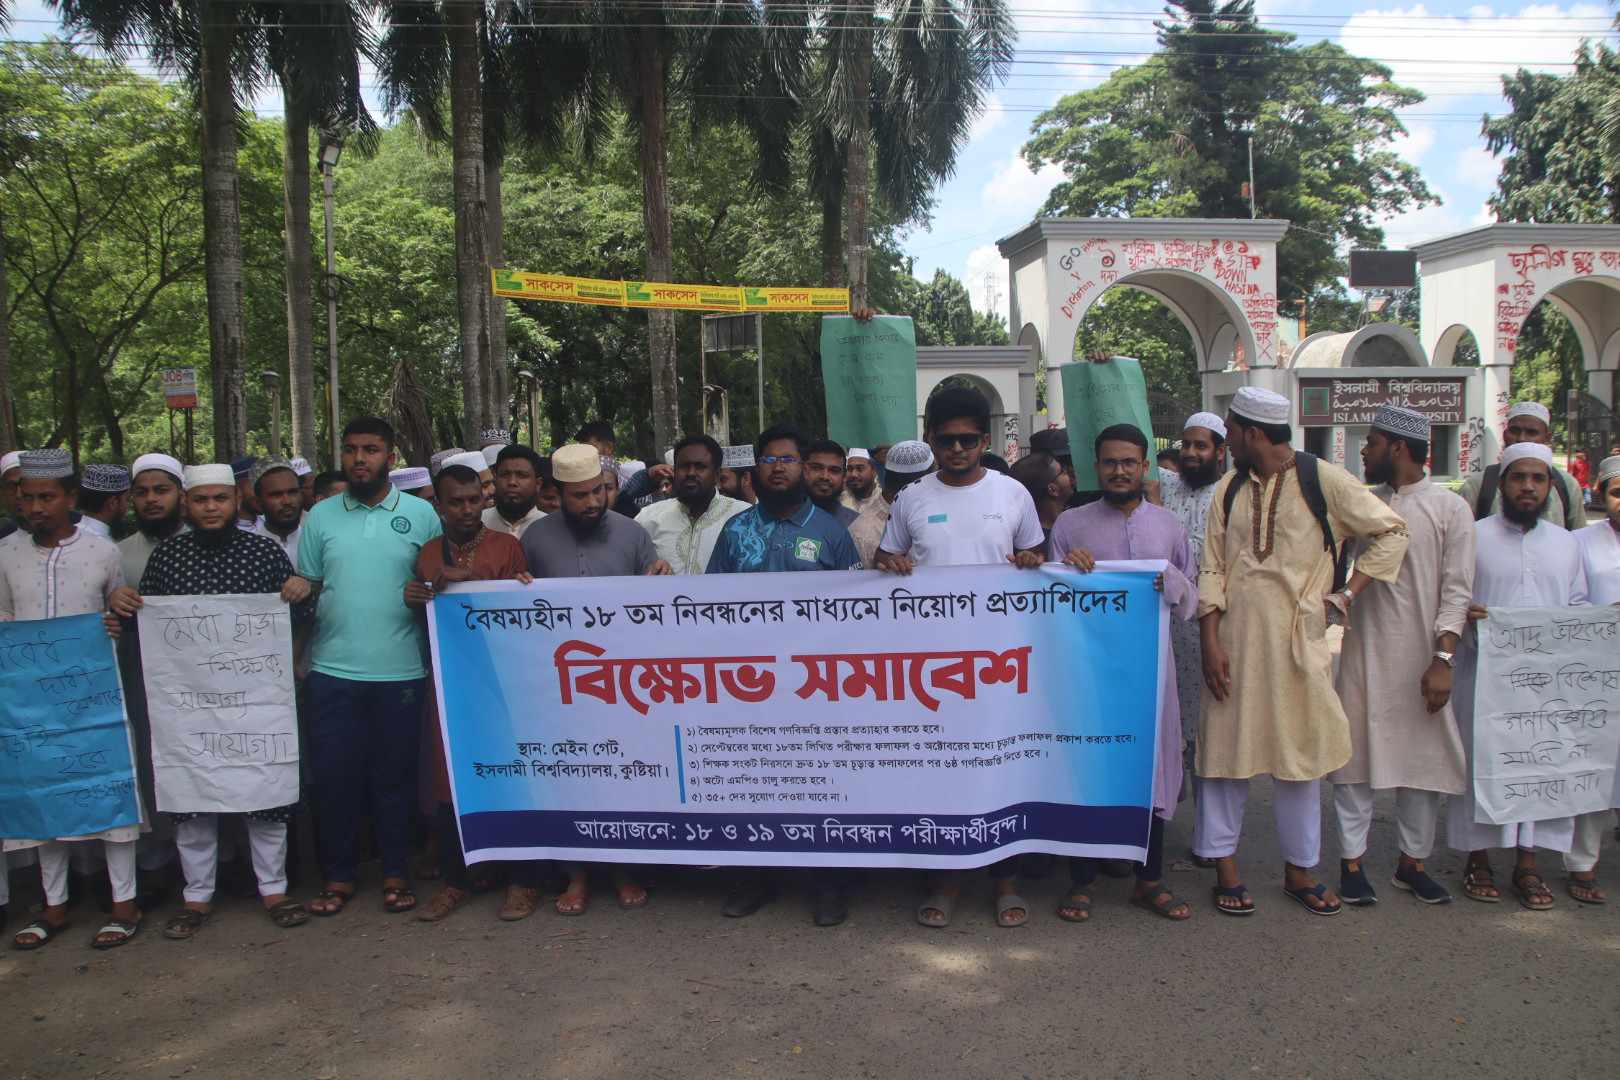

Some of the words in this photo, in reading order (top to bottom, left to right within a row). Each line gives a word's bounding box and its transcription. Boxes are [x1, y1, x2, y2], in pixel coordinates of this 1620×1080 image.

[526, 278, 574, 294] সাকসেস
[653, 288, 698, 302] সাকসেস
[1333, 378, 1379, 395] ইসলামী
[1388, 379, 1462, 395] বিশ্ববিদ্যালয়
[1333, 412, 1376, 423] ISLAMI
[463, 598, 573, 631] বৈষম্যহীন
[584, 604, 616, 629] ১৮
[624, 603, 664, 626] তম
[672, 596, 785, 625] নিবন্ধনের
[792, 597, 881, 624] মাধ্যমে
[889, 588, 977, 620] নিয়োগ
[986, 582, 1129, 617] প্রত্যাশিদের
[553, 640, 777, 716] বিক্ষোভ
[791, 645, 1033, 712] সমাবেশ
[749, 724, 776, 735] বিশেষ
[893, 725, 920, 734] করতে
[551, 740, 588, 758] মেইন
[593, 739, 625, 759] গেট,
[875, 742, 910, 752] ফলাফল
[1018, 731, 1053, 742] ফলাফল
[1055, 734, 1082, 744] প্রকাশ
[1085, 735, 1112, 744] করতে
[473, 760, 527, 779] ইসলামী
[531, 760, 618, 780] বিশ্ববিদ্যালয়,
[575, 818, 678, 842] আয়োজনে:
[685, 821, 713, 842] ১৮
[720, 821, 738, 842] ও
[747, 822, 775, 843] ১৯
[781, 822, 816, 844] তম
[823, 817, 892, 845] নিবন্ধন
